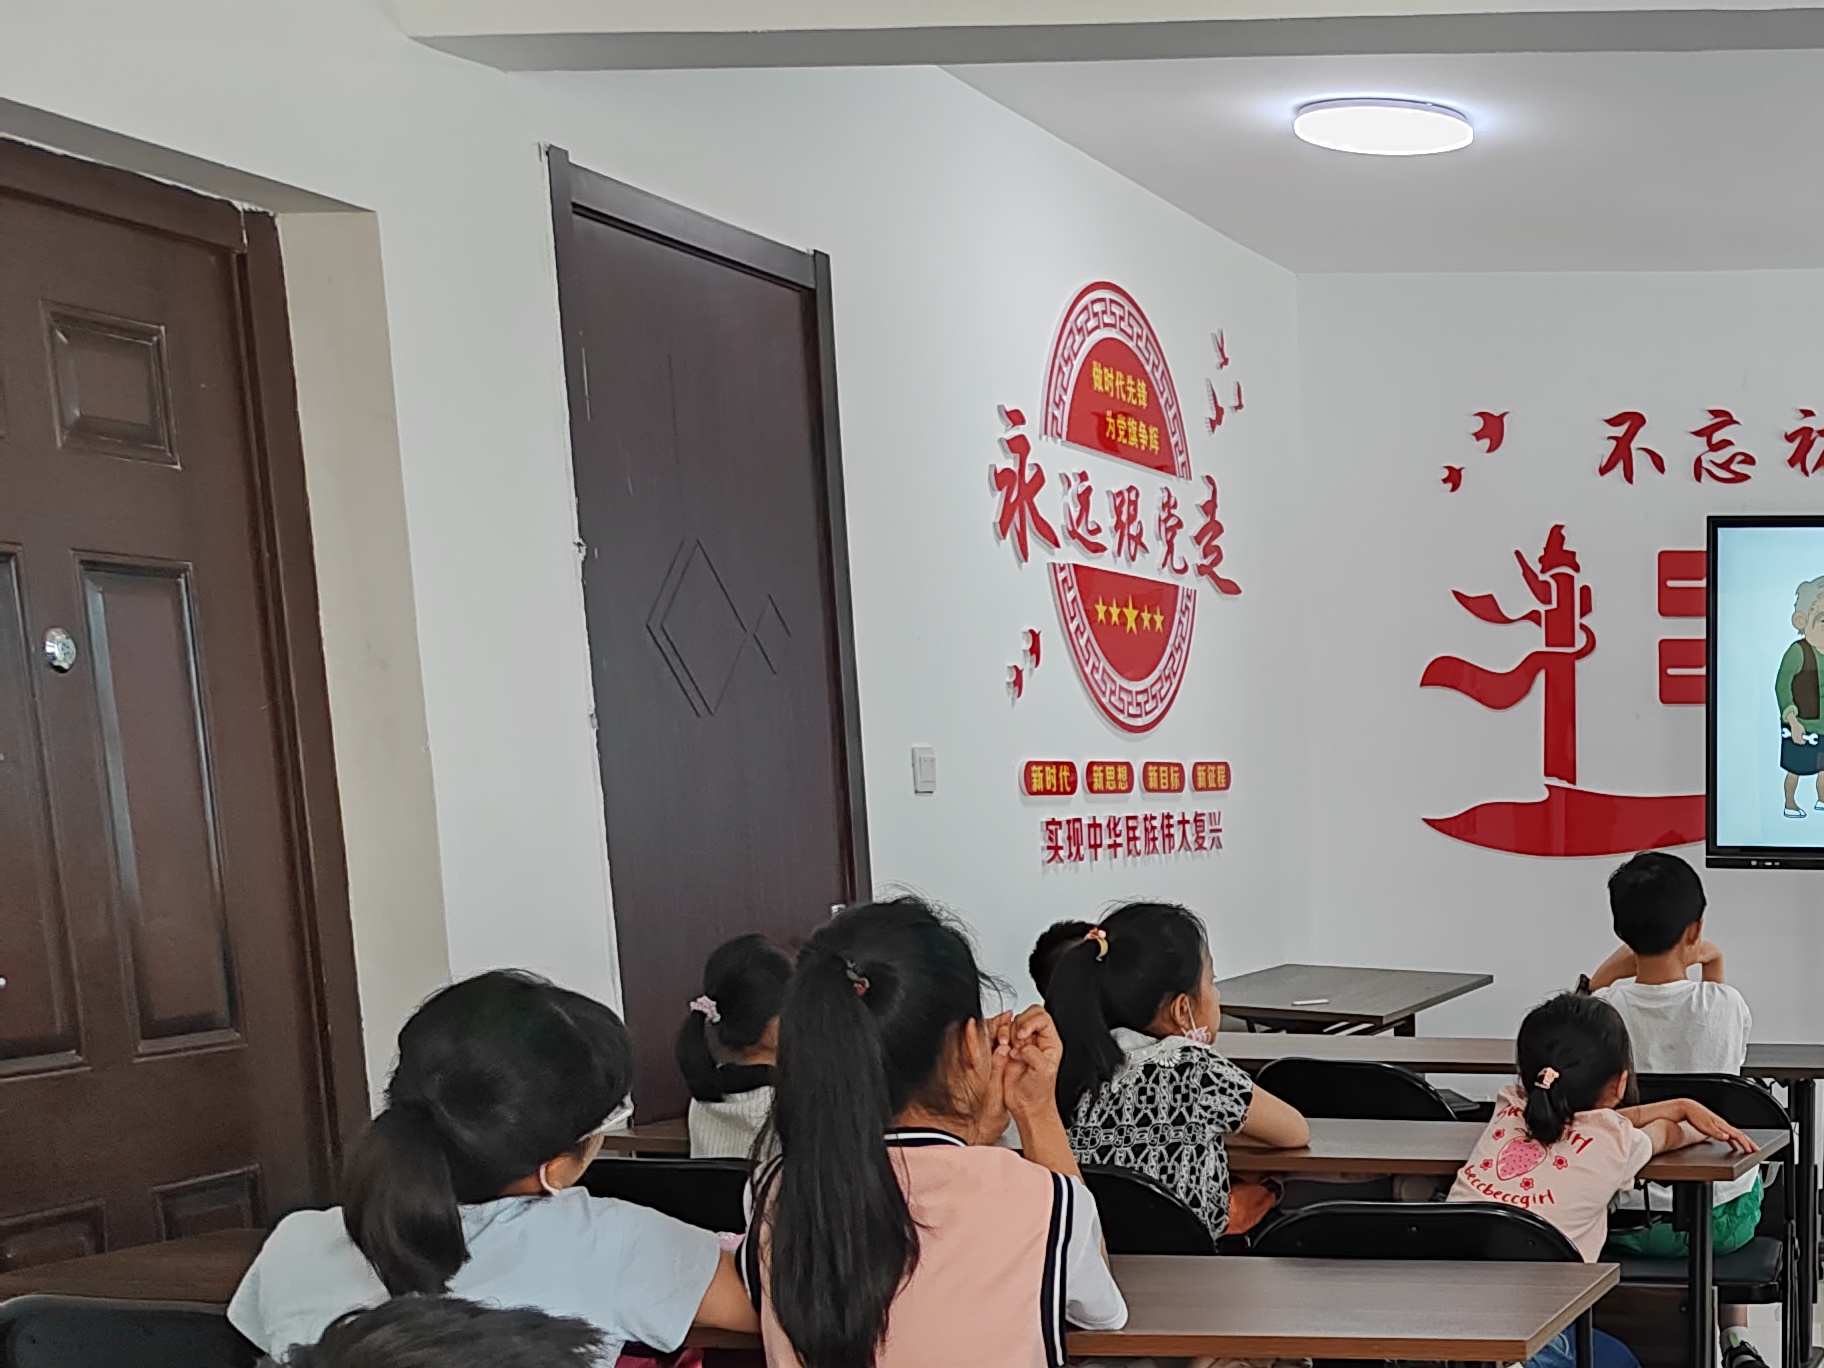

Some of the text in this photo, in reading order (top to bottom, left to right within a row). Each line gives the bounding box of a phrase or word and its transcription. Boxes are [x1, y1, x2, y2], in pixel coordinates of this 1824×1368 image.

[1092, 360, 1147, 410] 做时代先锋
[1105, 410, 1159, 455] 为党旗争辉
[993, 407, 1243, 595] 永远跟党走
[1031, 765, 1071, 792] 新时代
[1092, 764, 1128, 791] 新思想
[1148, 765, 1180, 790] 新目标
[1196, 764, 1226, 789] 新征程
[1045, 811, 1223, 864] 实现中华民族伟大复兴
[1464, 1164, 1555, 1209] beccbeccgirl
